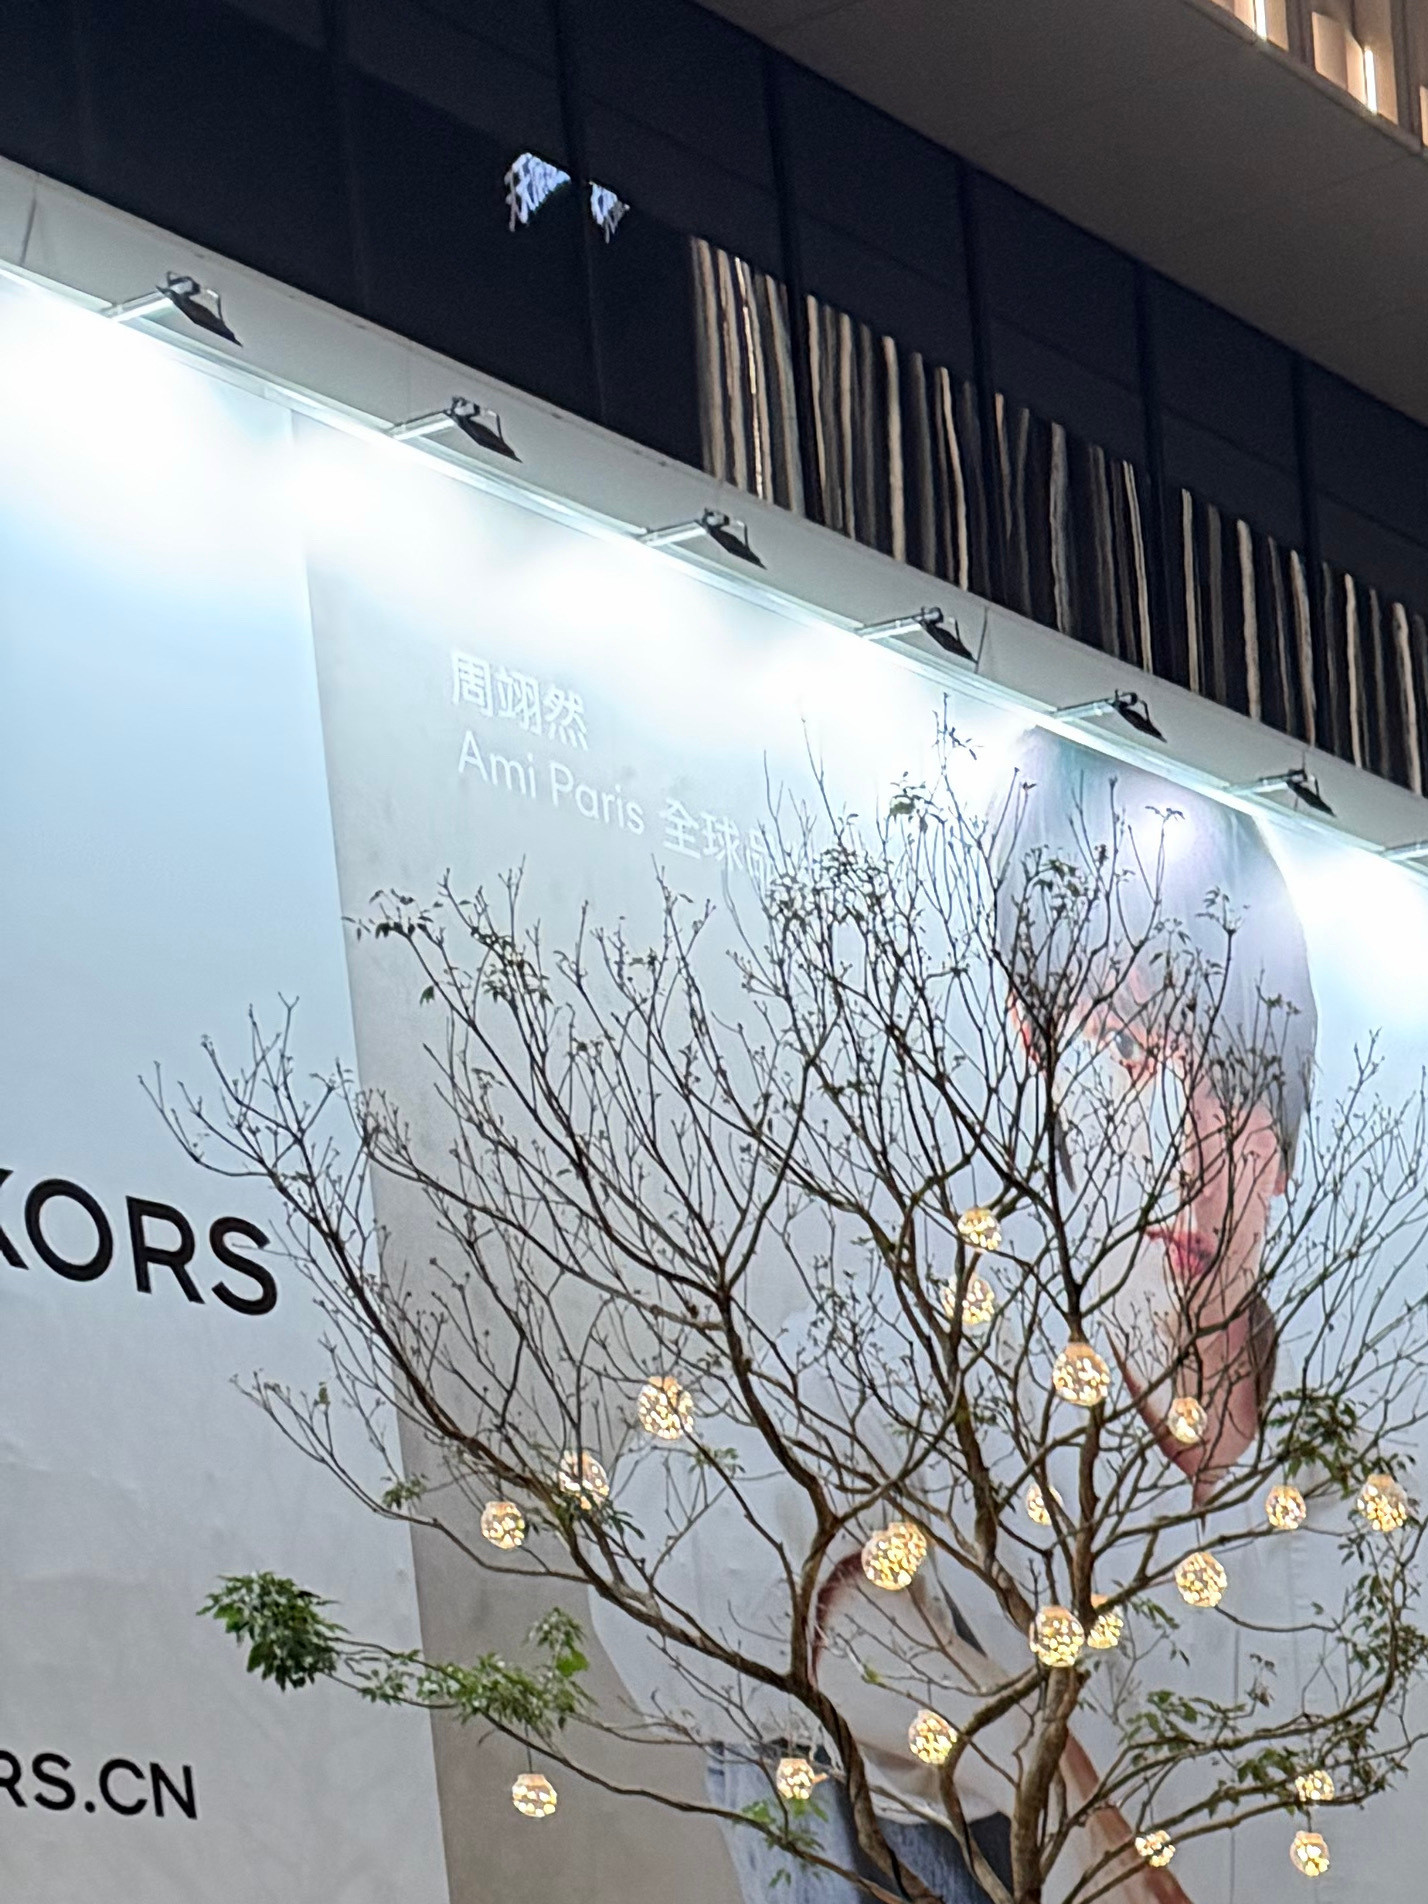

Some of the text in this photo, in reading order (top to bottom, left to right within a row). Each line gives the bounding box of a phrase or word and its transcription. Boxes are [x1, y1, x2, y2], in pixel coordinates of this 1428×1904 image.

[450, 648, 590, 751] 周翊然
[457, 729, 537, 799] Ami
[549, 760, 645, 836] Paris
